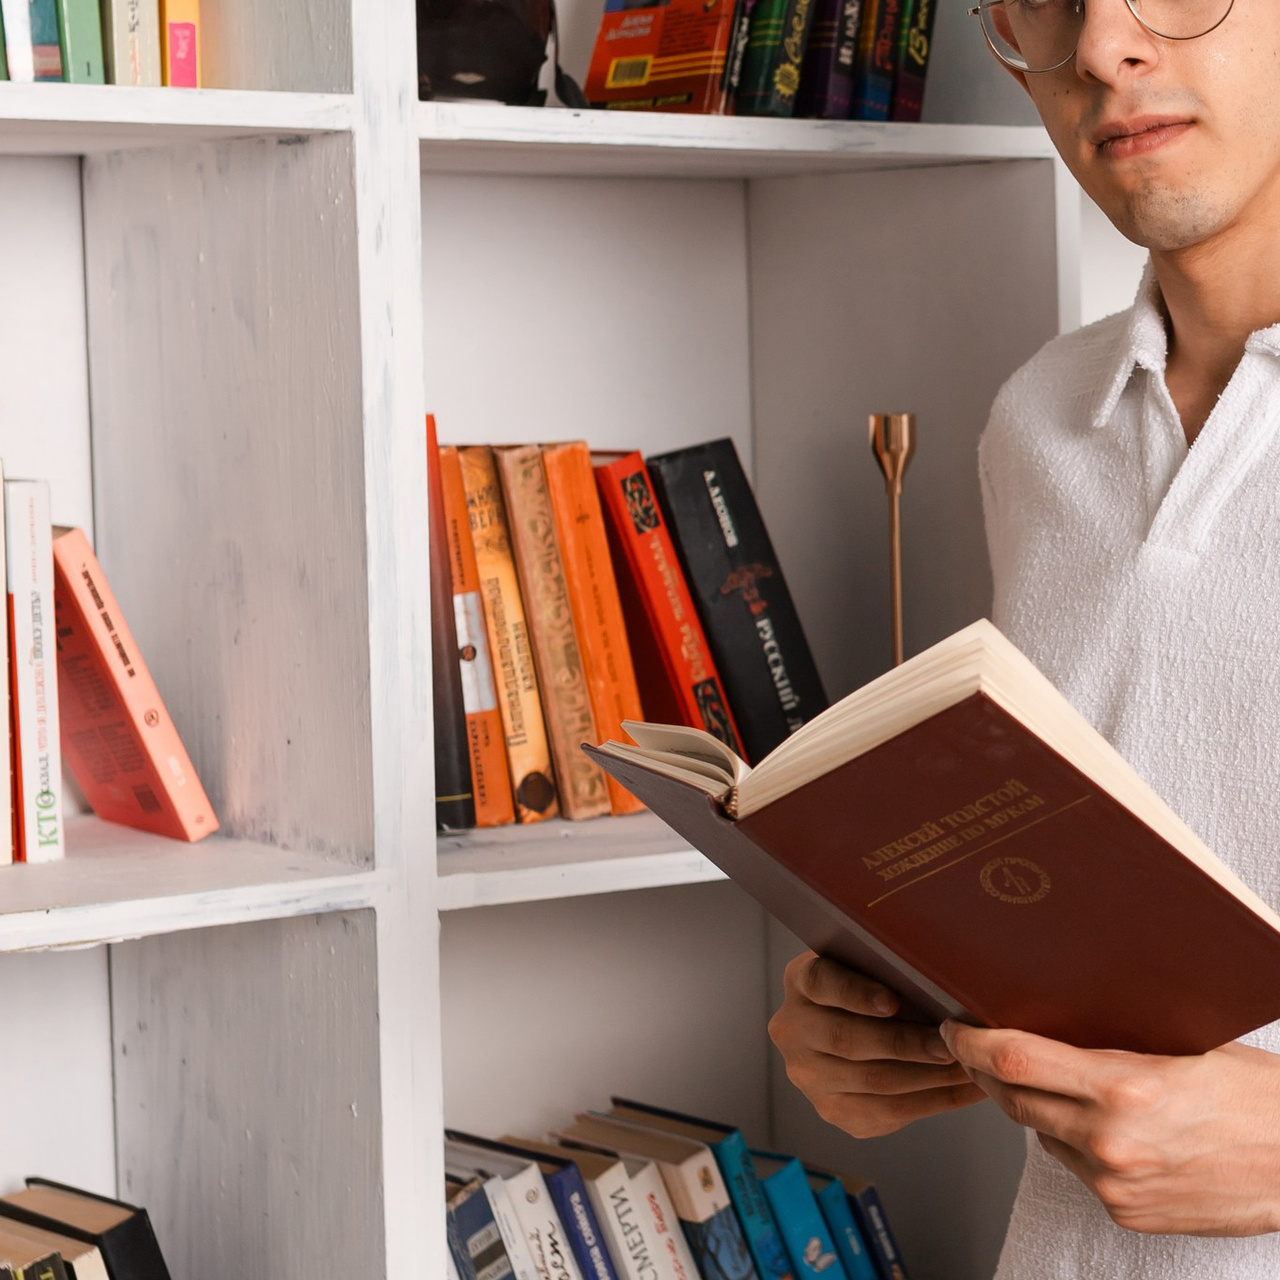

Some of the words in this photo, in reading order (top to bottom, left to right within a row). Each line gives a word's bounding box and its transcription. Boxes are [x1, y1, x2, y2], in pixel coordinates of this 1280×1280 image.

[752, 617, 801, 710] РУССКИЙ
[34, 789, 59, 847] КТО
[861, 822, 945, 870] АЛЕКСЕЙ
[941, 778, 1029, 830] ТОЛСТОЙ
[876, 831, 963, 882] ХОЖДЕНИЕ
[960, 823, 985, 842] ПО
[987, 794, 1044, 829] МУКАМ
